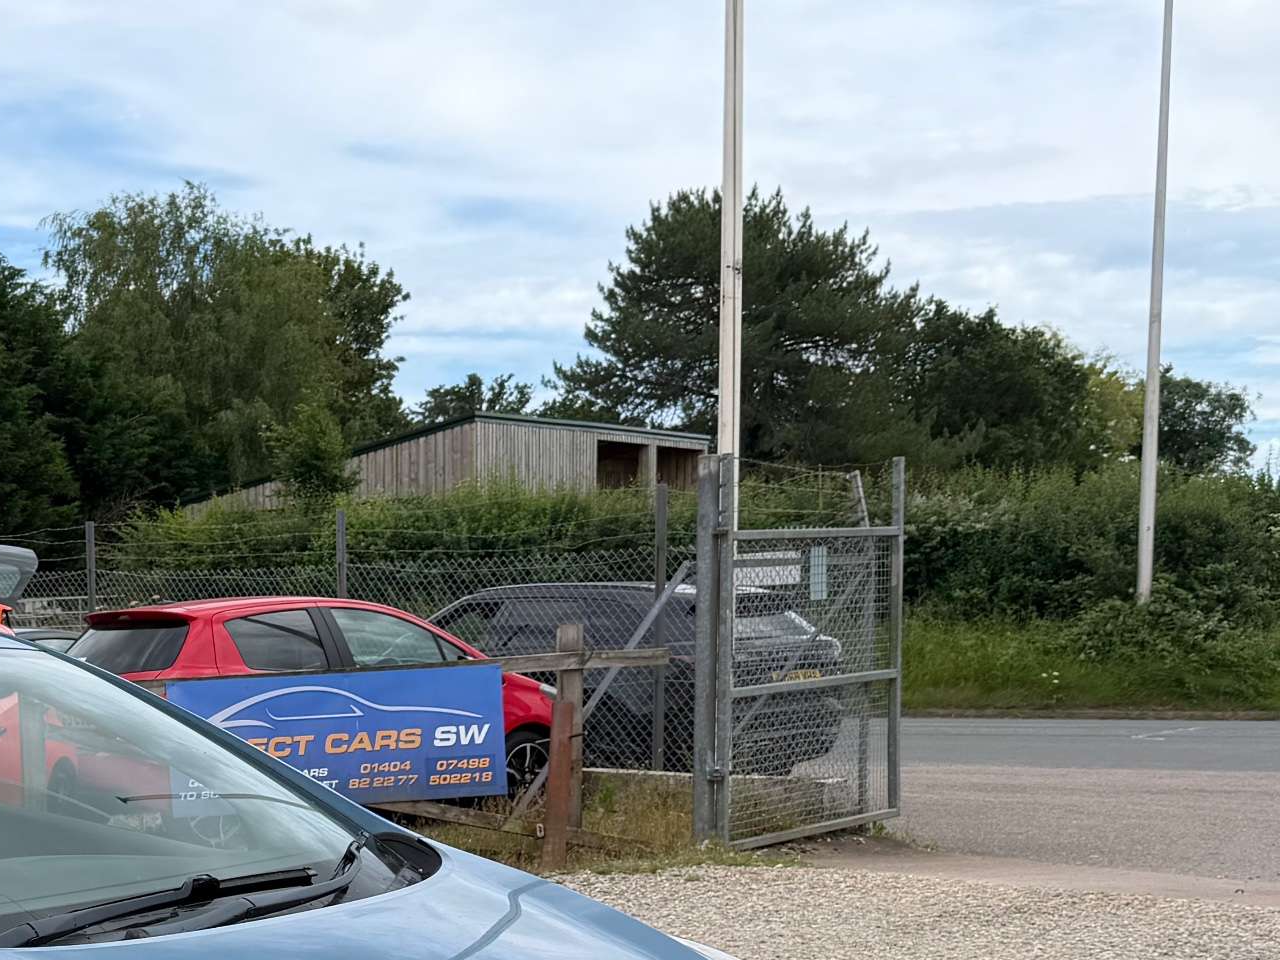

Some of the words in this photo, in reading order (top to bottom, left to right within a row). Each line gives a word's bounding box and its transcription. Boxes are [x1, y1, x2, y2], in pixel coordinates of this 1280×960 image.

[324, 727, 423, 754] CARS
[433, 723, 491, 747] SW
[360, 760, 412, 774] 01404
[436, 757, 492, 771] 07498
[302, 767, 329, 778] ARS
[428, 771, 494, 786] 502218
